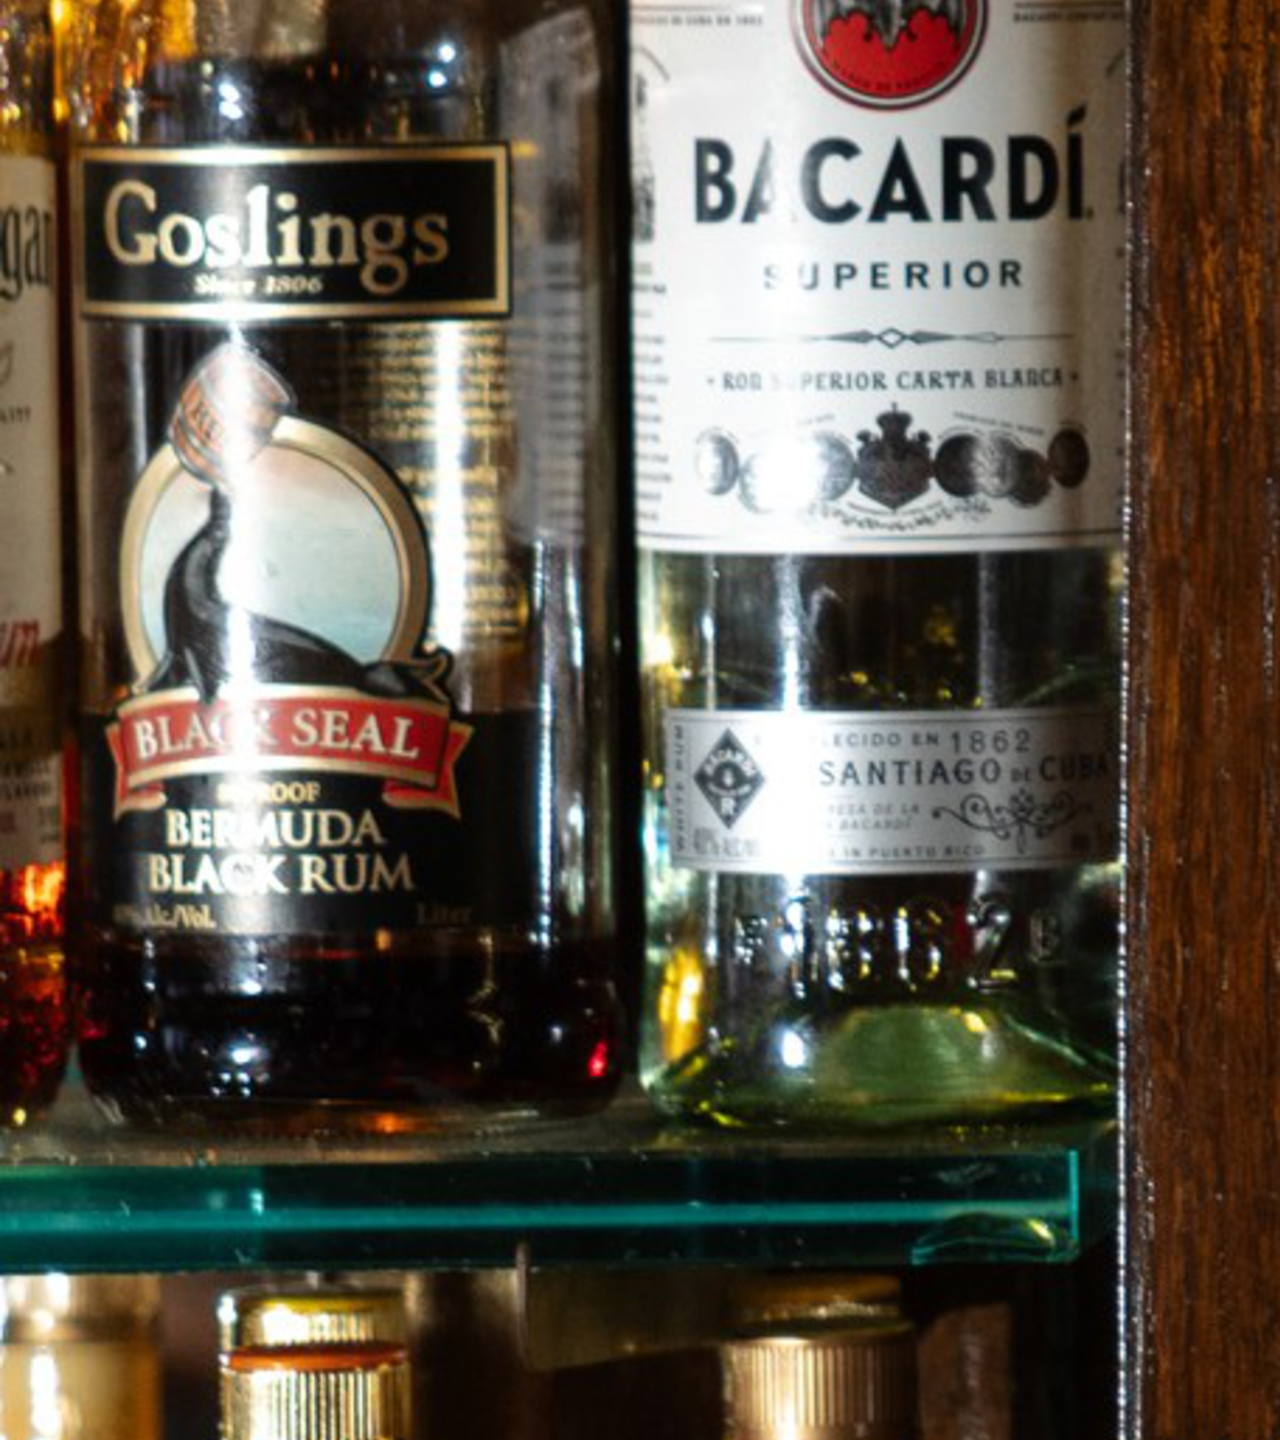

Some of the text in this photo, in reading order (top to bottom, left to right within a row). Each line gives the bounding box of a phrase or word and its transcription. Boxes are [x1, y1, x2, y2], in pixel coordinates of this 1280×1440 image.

[103, 179, 451, 296] Goslings
[762, 259, 1024, 291] SUPERIOR
[898, 367, 976, 390] CARTA
[290, 707, 421, 760] SEAL
[911, 730, 941, 748] EN
[949, 726, 1033, 756] 1862
[818, 757, 1001, 789] SANTIAGO
[165, 807, 388, 849] BERMUDA
[149, 852, 416, 896] BLACK RUM
